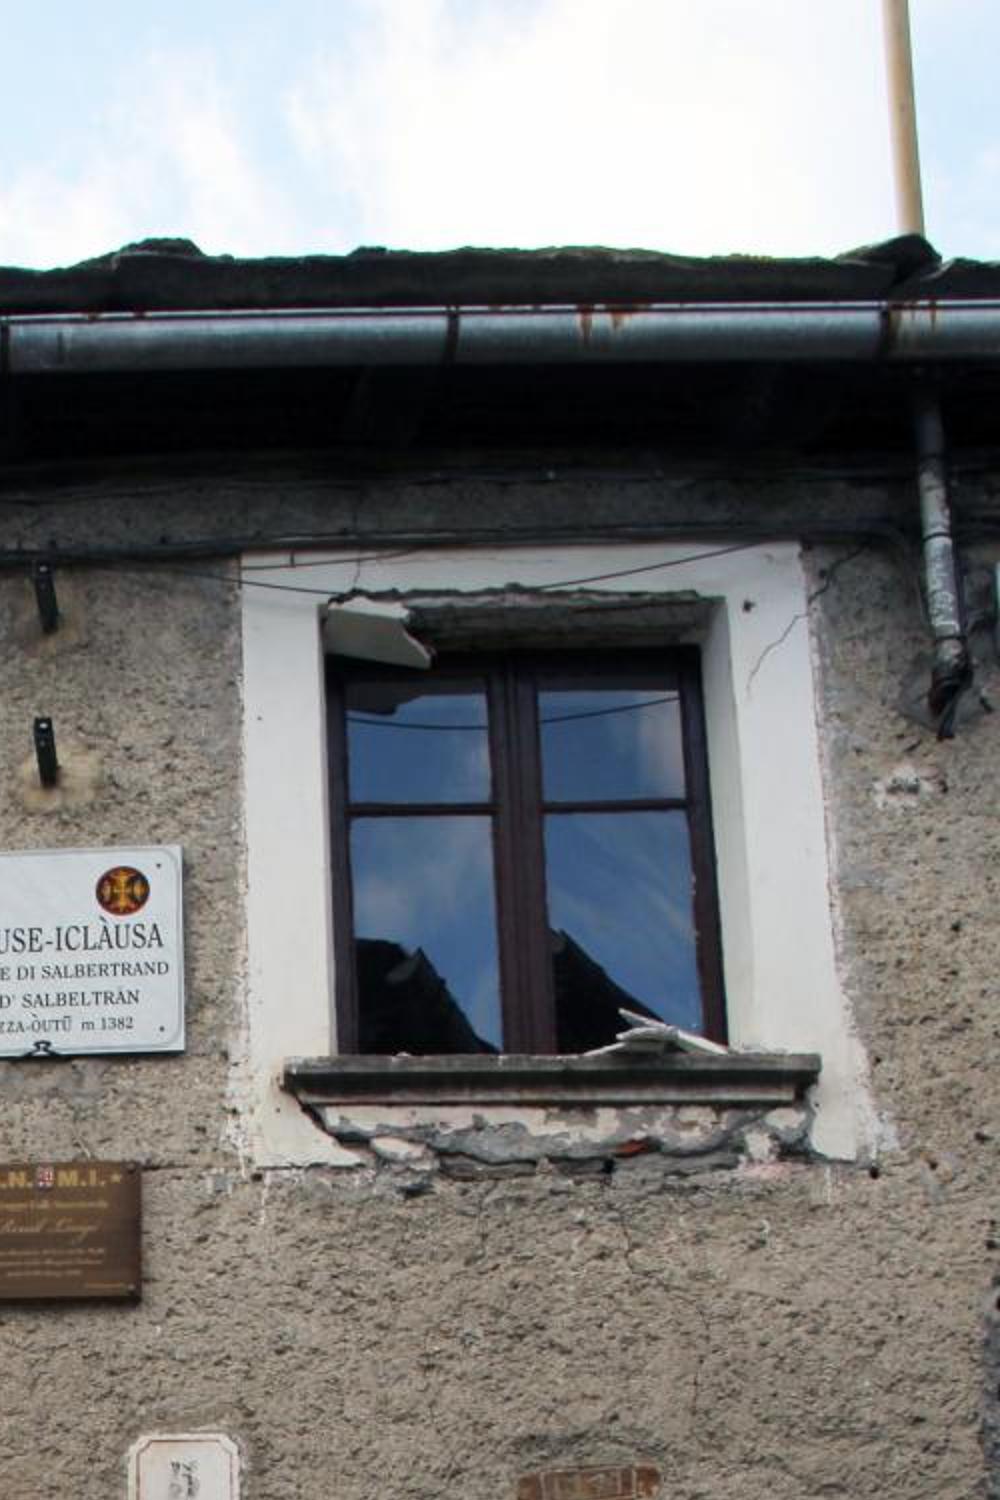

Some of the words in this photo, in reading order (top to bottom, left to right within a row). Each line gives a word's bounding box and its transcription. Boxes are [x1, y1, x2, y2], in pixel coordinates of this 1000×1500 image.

[17, 966, 36, 980] DI
[41, 961, 169, 979] SALBERTRAND
[81, 1020, 95, 1031] m
[101, 1017, 134, 1030] 1382
